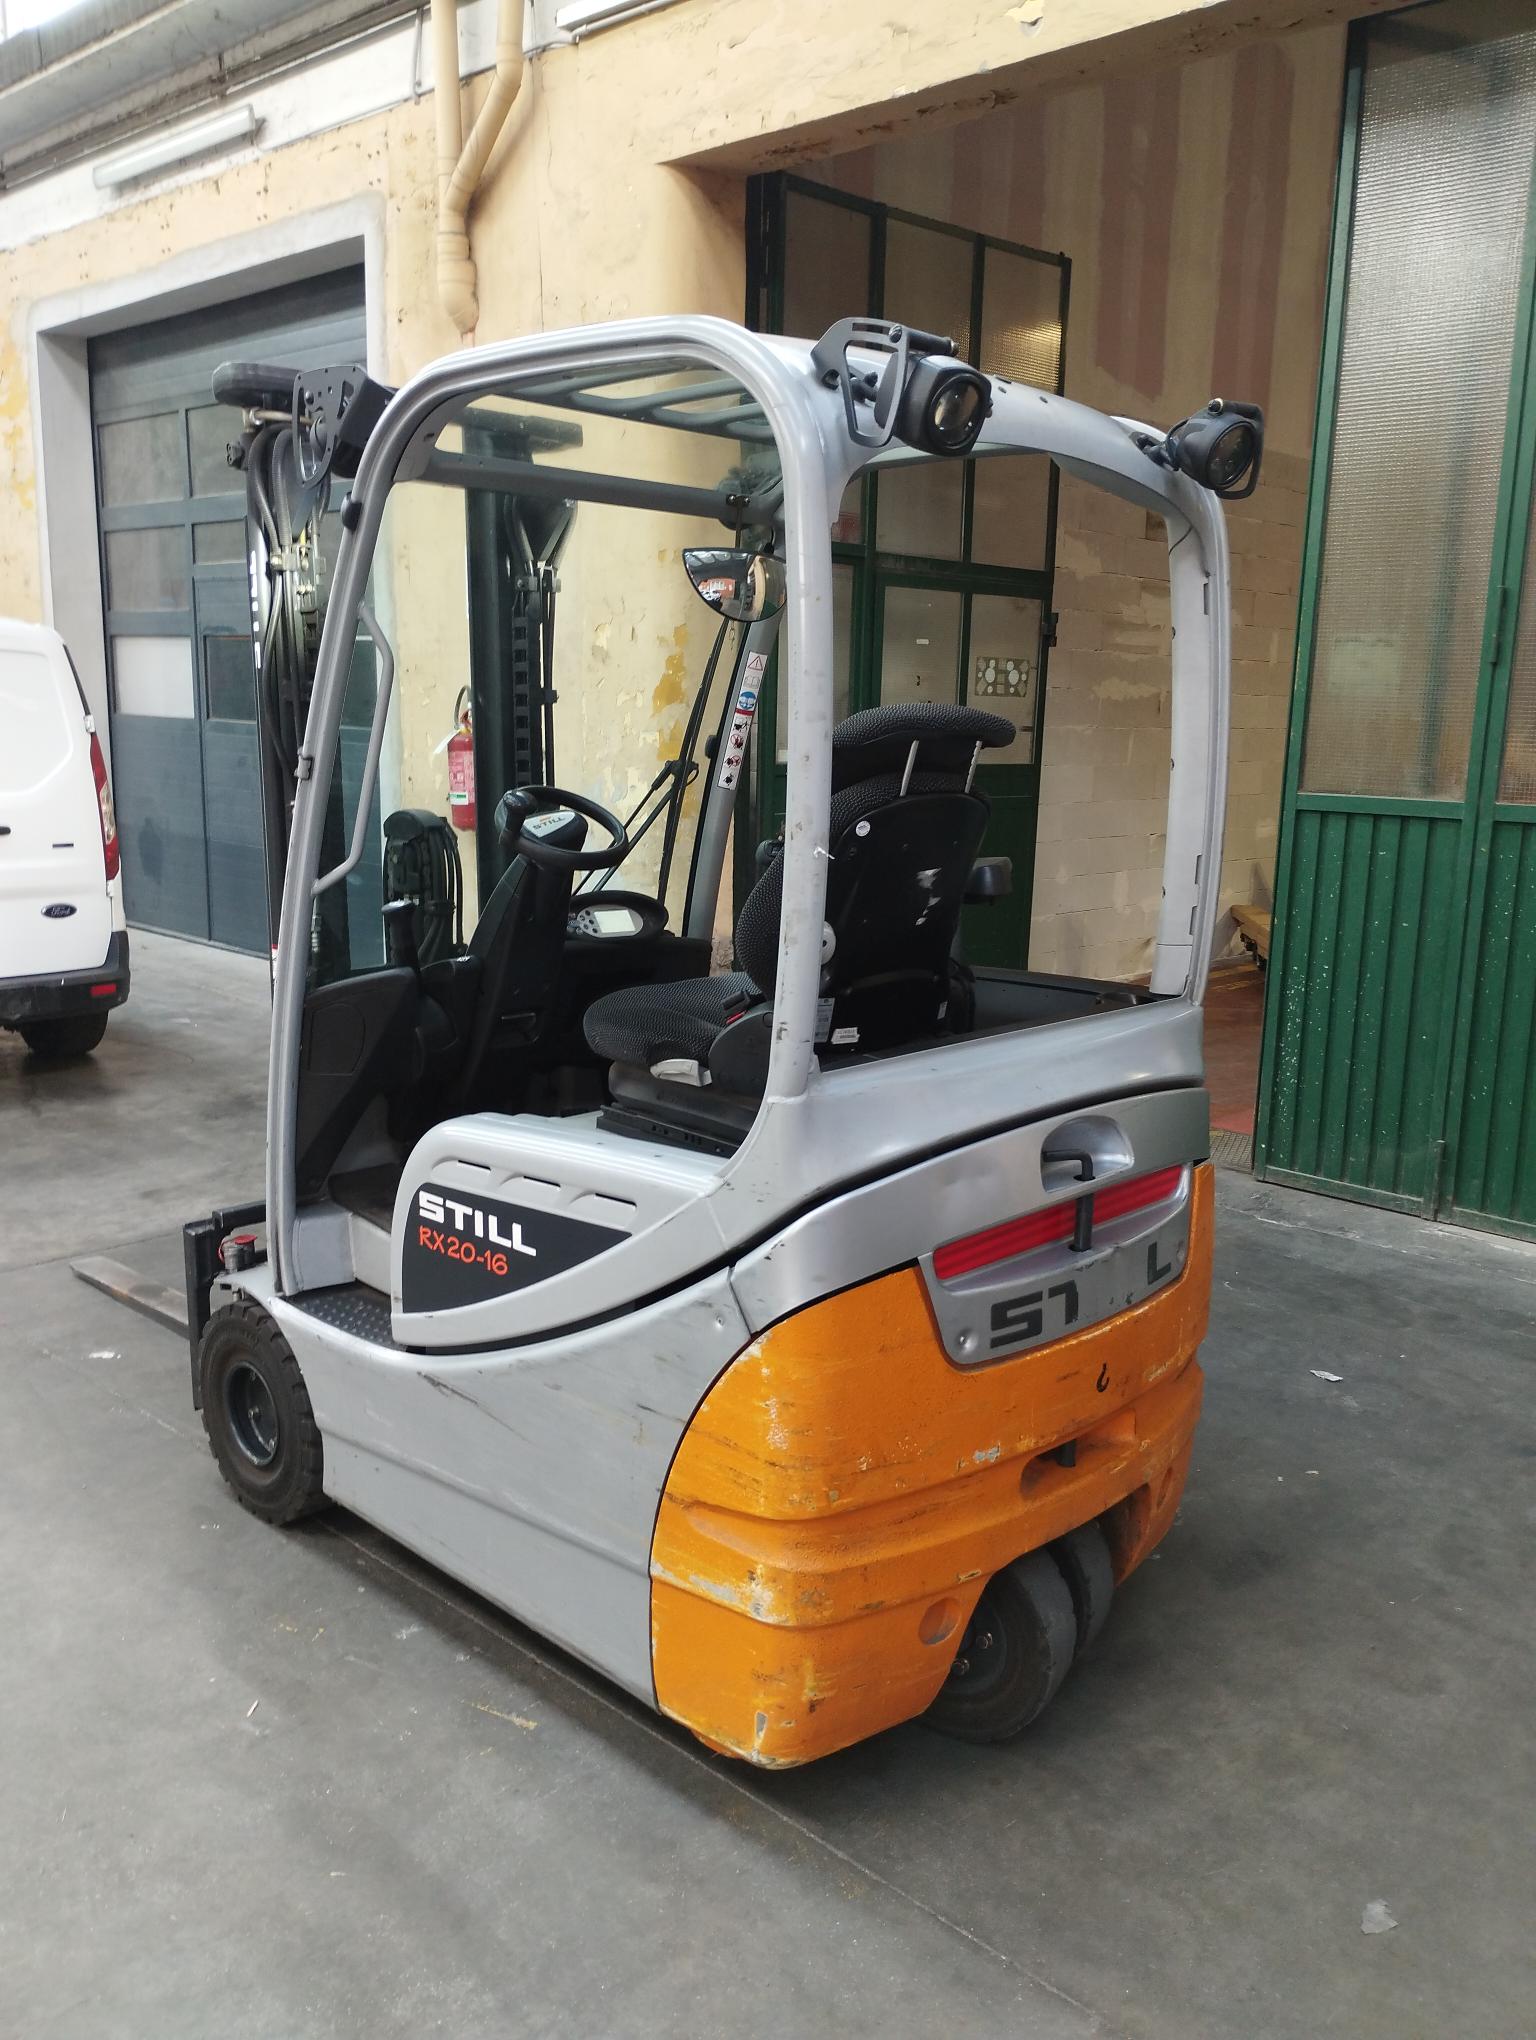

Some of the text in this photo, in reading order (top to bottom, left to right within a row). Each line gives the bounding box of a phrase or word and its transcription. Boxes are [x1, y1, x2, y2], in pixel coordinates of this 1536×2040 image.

[533, 815, 566, 830] STILL
[419, 1190, 537, 1257] STILL
[419, 1225, 508, 1276] RX20-16
[990, 1242, 1171, 1349] STL
